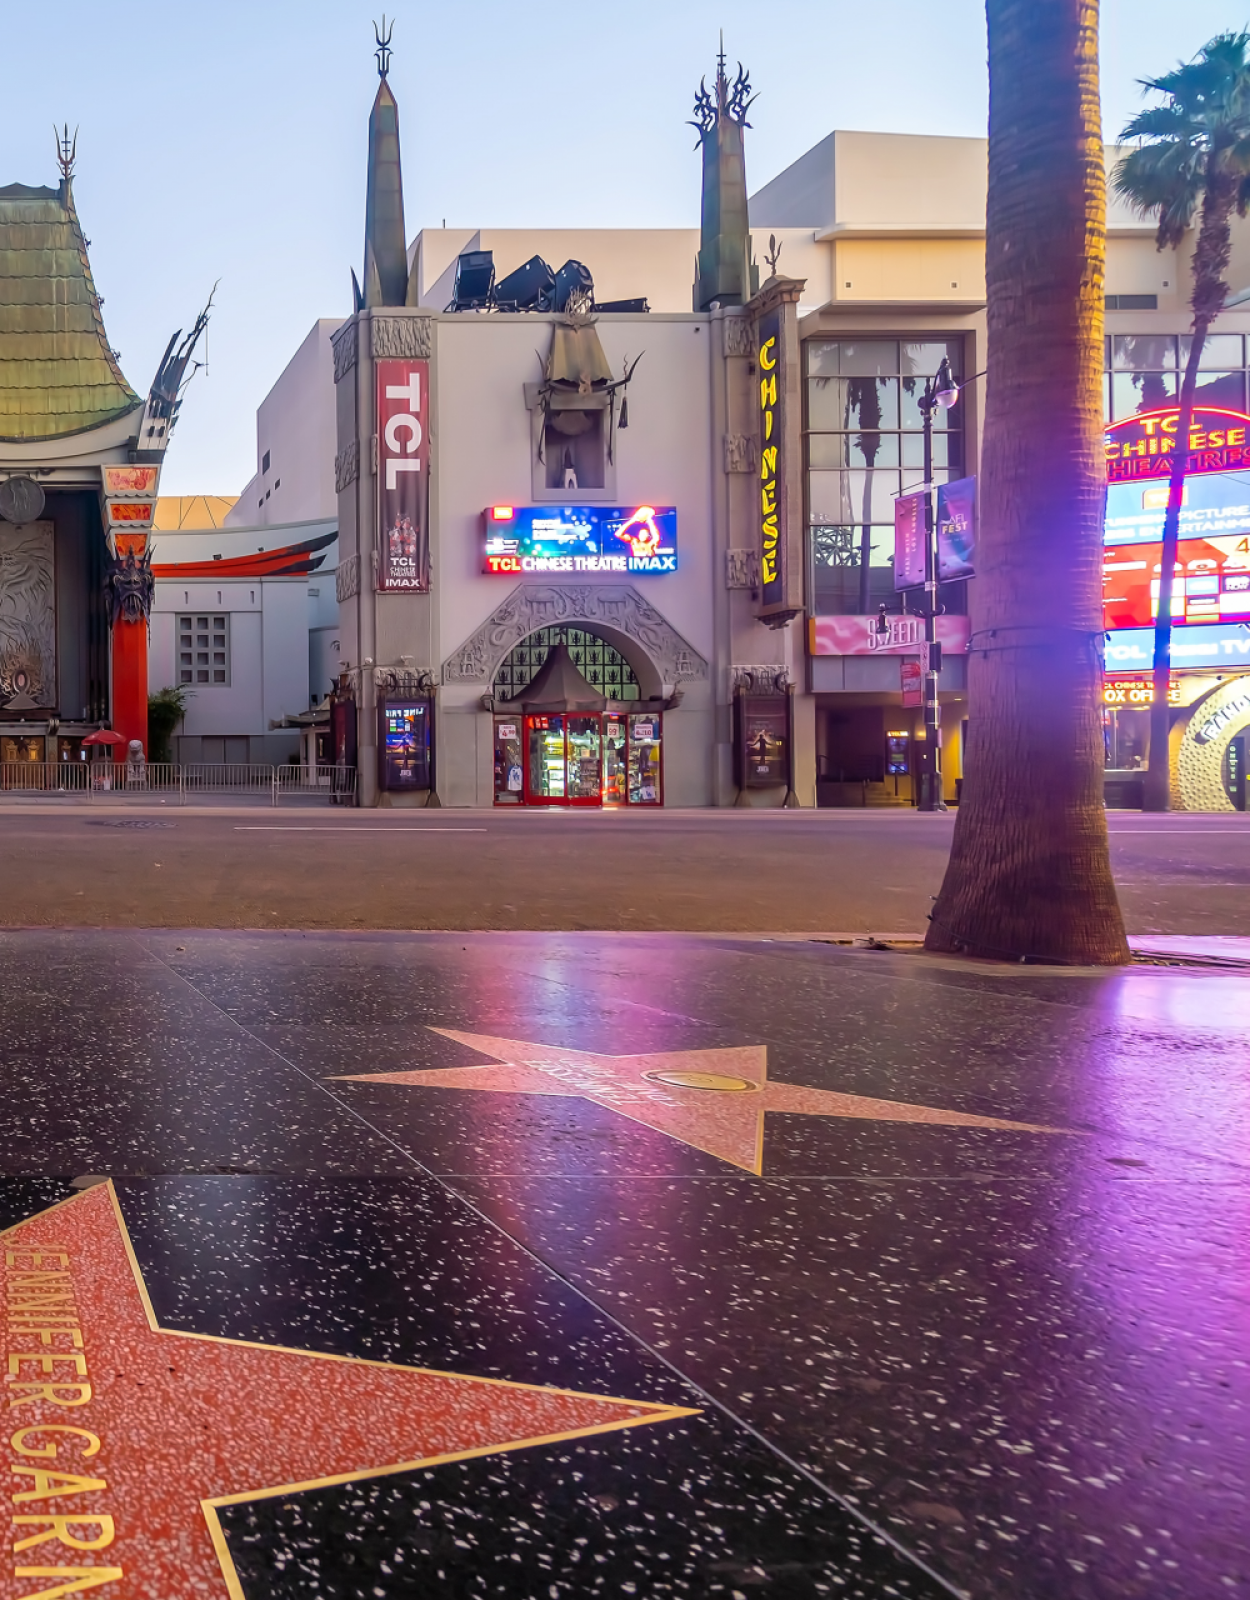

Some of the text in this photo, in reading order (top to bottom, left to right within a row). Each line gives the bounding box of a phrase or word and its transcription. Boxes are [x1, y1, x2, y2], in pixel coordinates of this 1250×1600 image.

[385, 373, 422, 491] TCL
[1140, 414, 1203, 435] TCL
[1104, 427, 1247, 460] CHINESE
[759, 335, 779, 585] CHINESE
[941, 521, 968, 535] FEST
[390, 557, 416, 566] TCL
[489, 556, 676, 571] TCL CHINESE THEATRE IMAX
[385, 579, 420, 587] IMAX
[4, 1238, 92, 1407] JENNIFER
